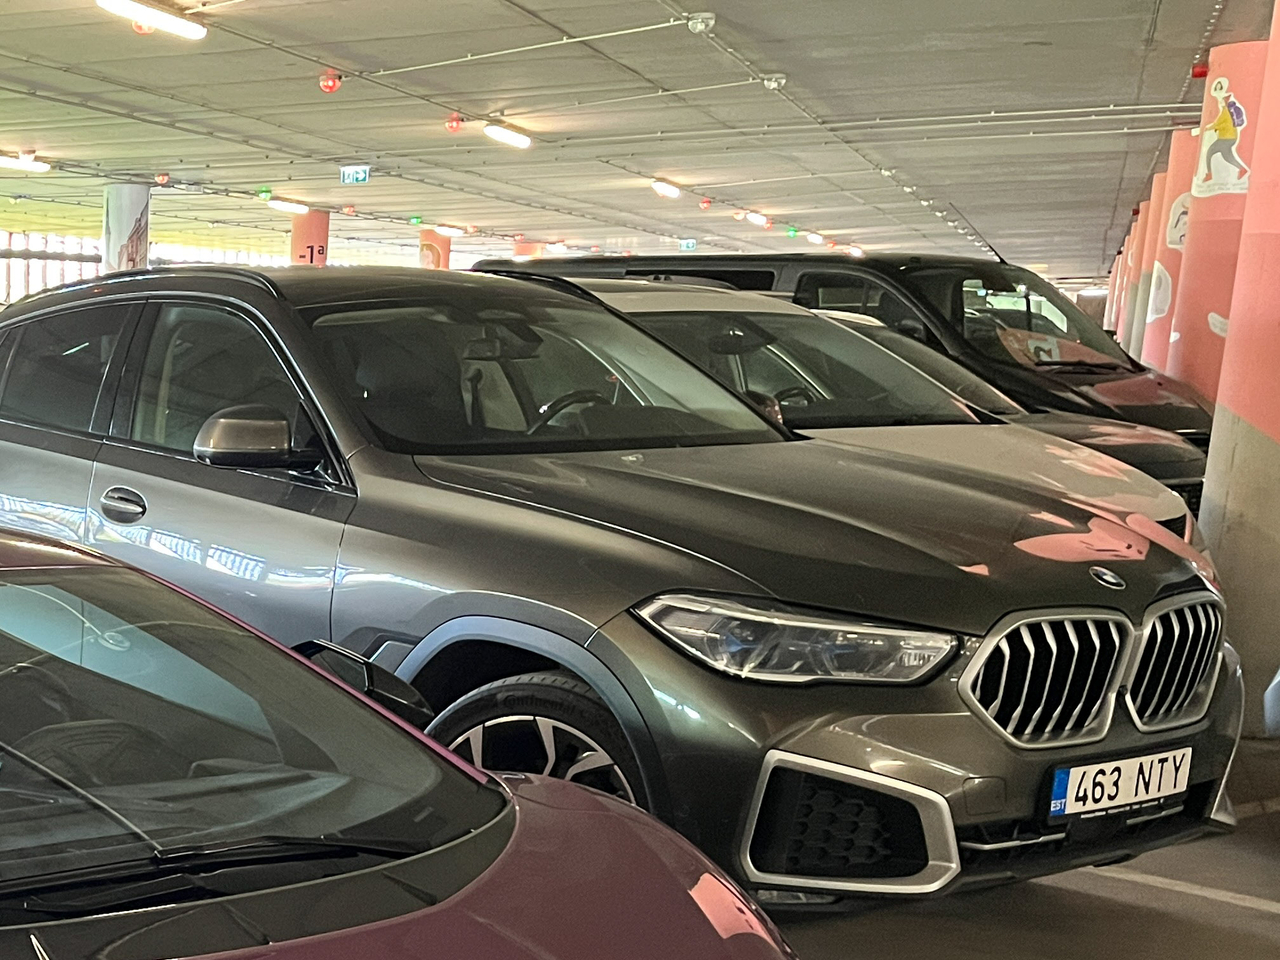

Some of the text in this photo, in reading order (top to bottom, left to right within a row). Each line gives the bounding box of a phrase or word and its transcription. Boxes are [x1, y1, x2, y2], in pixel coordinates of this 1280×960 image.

[1074, 752, 1186, 807] 463 NTY
[1050, 800, 1066, 812] EST
